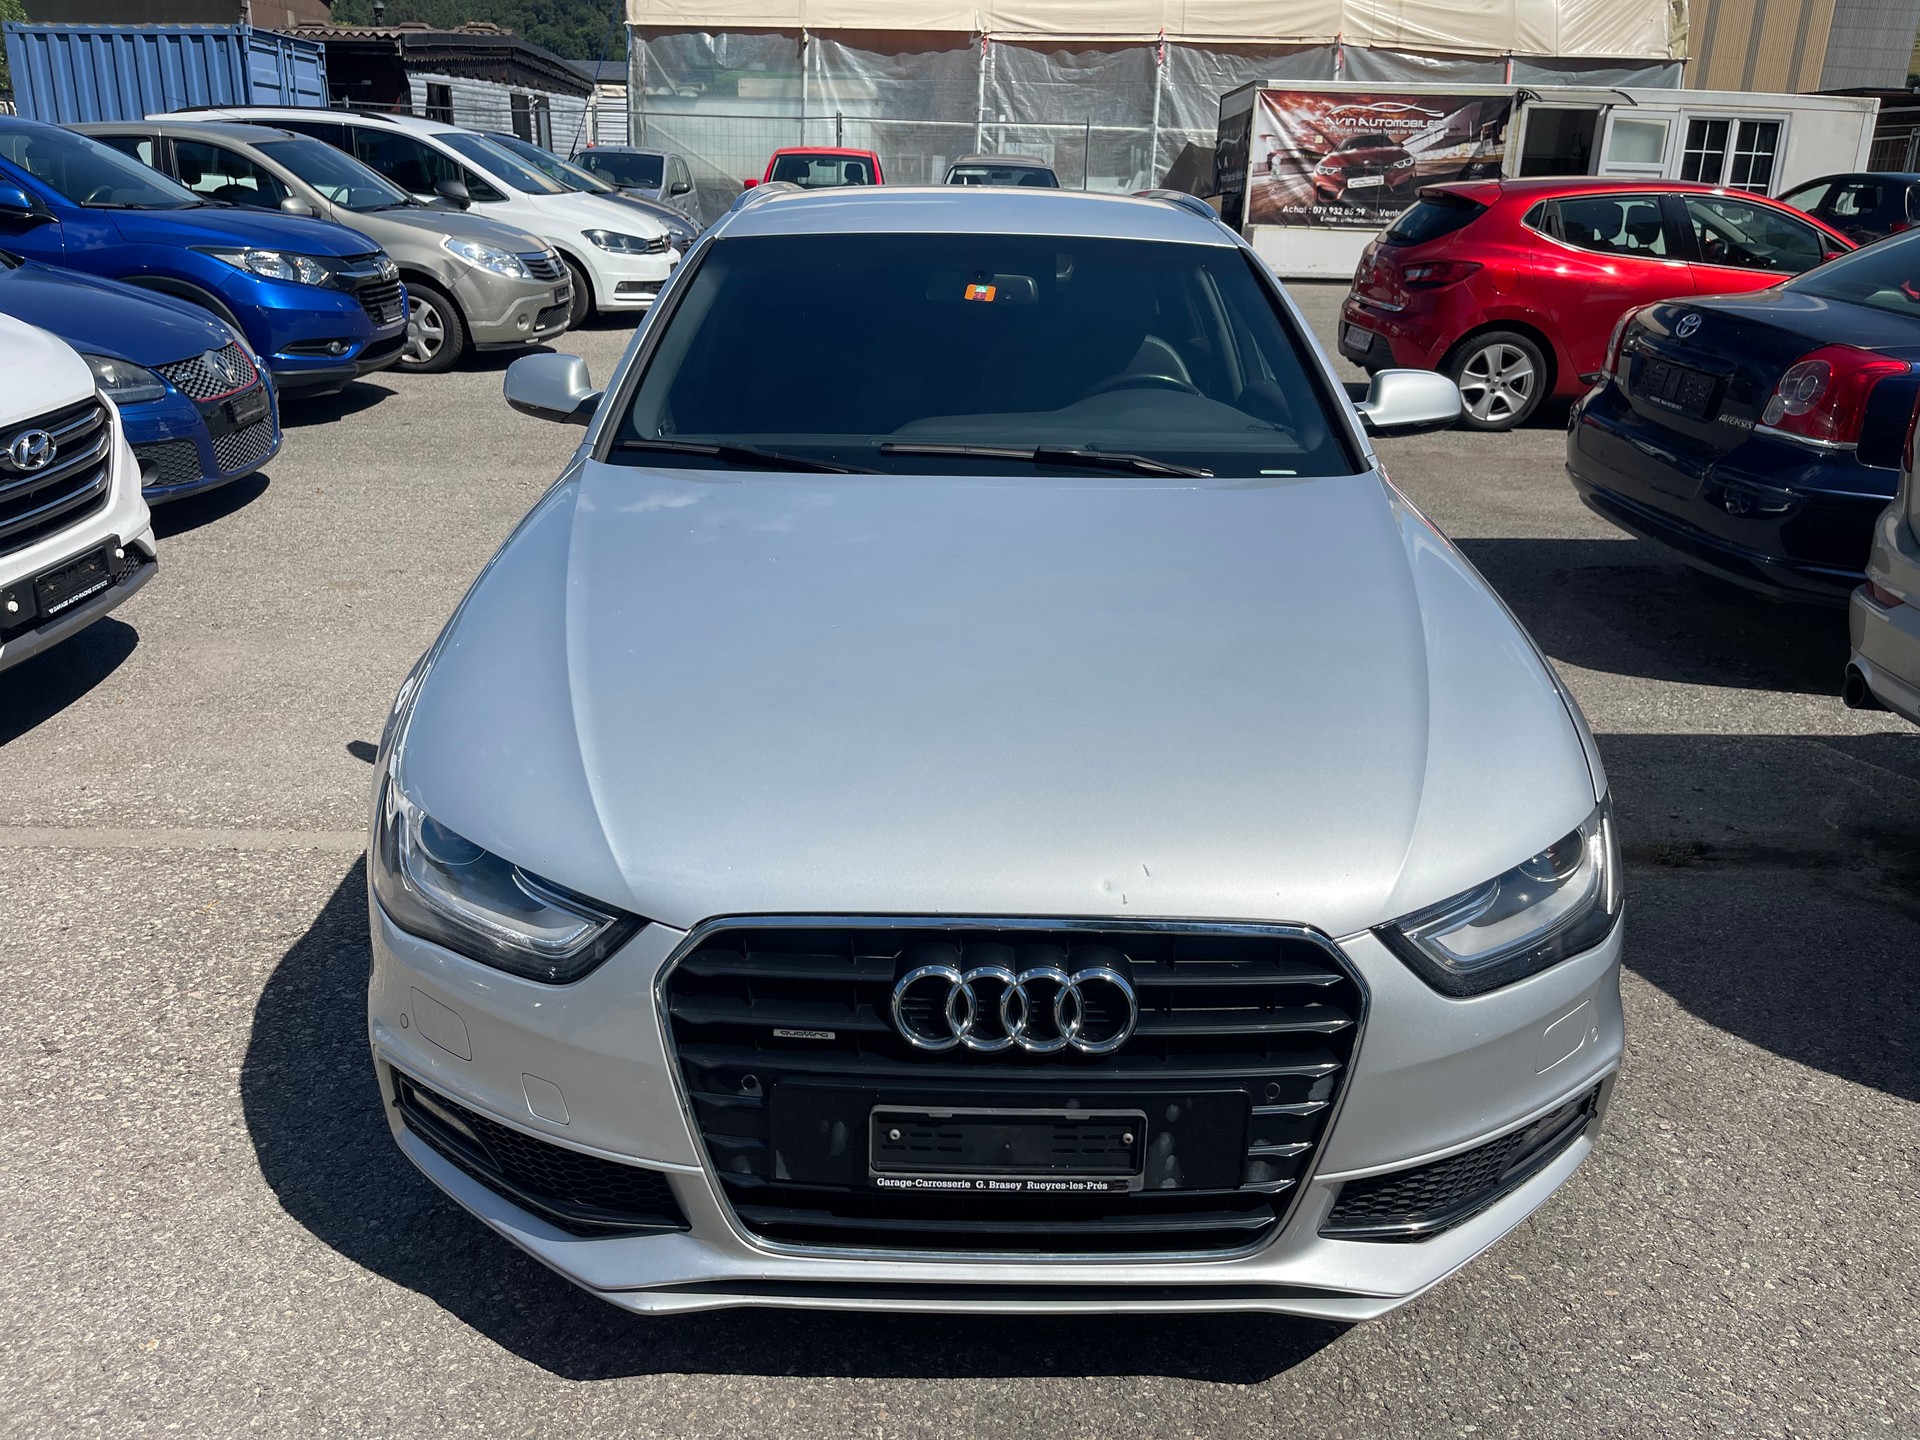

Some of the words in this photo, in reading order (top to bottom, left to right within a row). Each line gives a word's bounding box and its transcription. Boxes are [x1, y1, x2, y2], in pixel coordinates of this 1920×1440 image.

[1358, 117, 1444, 128] AUTOMOBILES
[1282, 204, 1307, 214] Achat
[1312, 205, 1327, 215] 079
[1329, 206, 1343, 216] 932
[1718, 414, 1753, 429] AVENSIS
[780, 1030, 829, 1038] quattro
[876, 1177, 971, 1189] Garage-Carrosserie
[975, 1180, 987, 1189] G.
[988, 1180, 1022, 1191] Brasey
[1026, 1181, 1108, 1191] Rueyres-les-Prés
